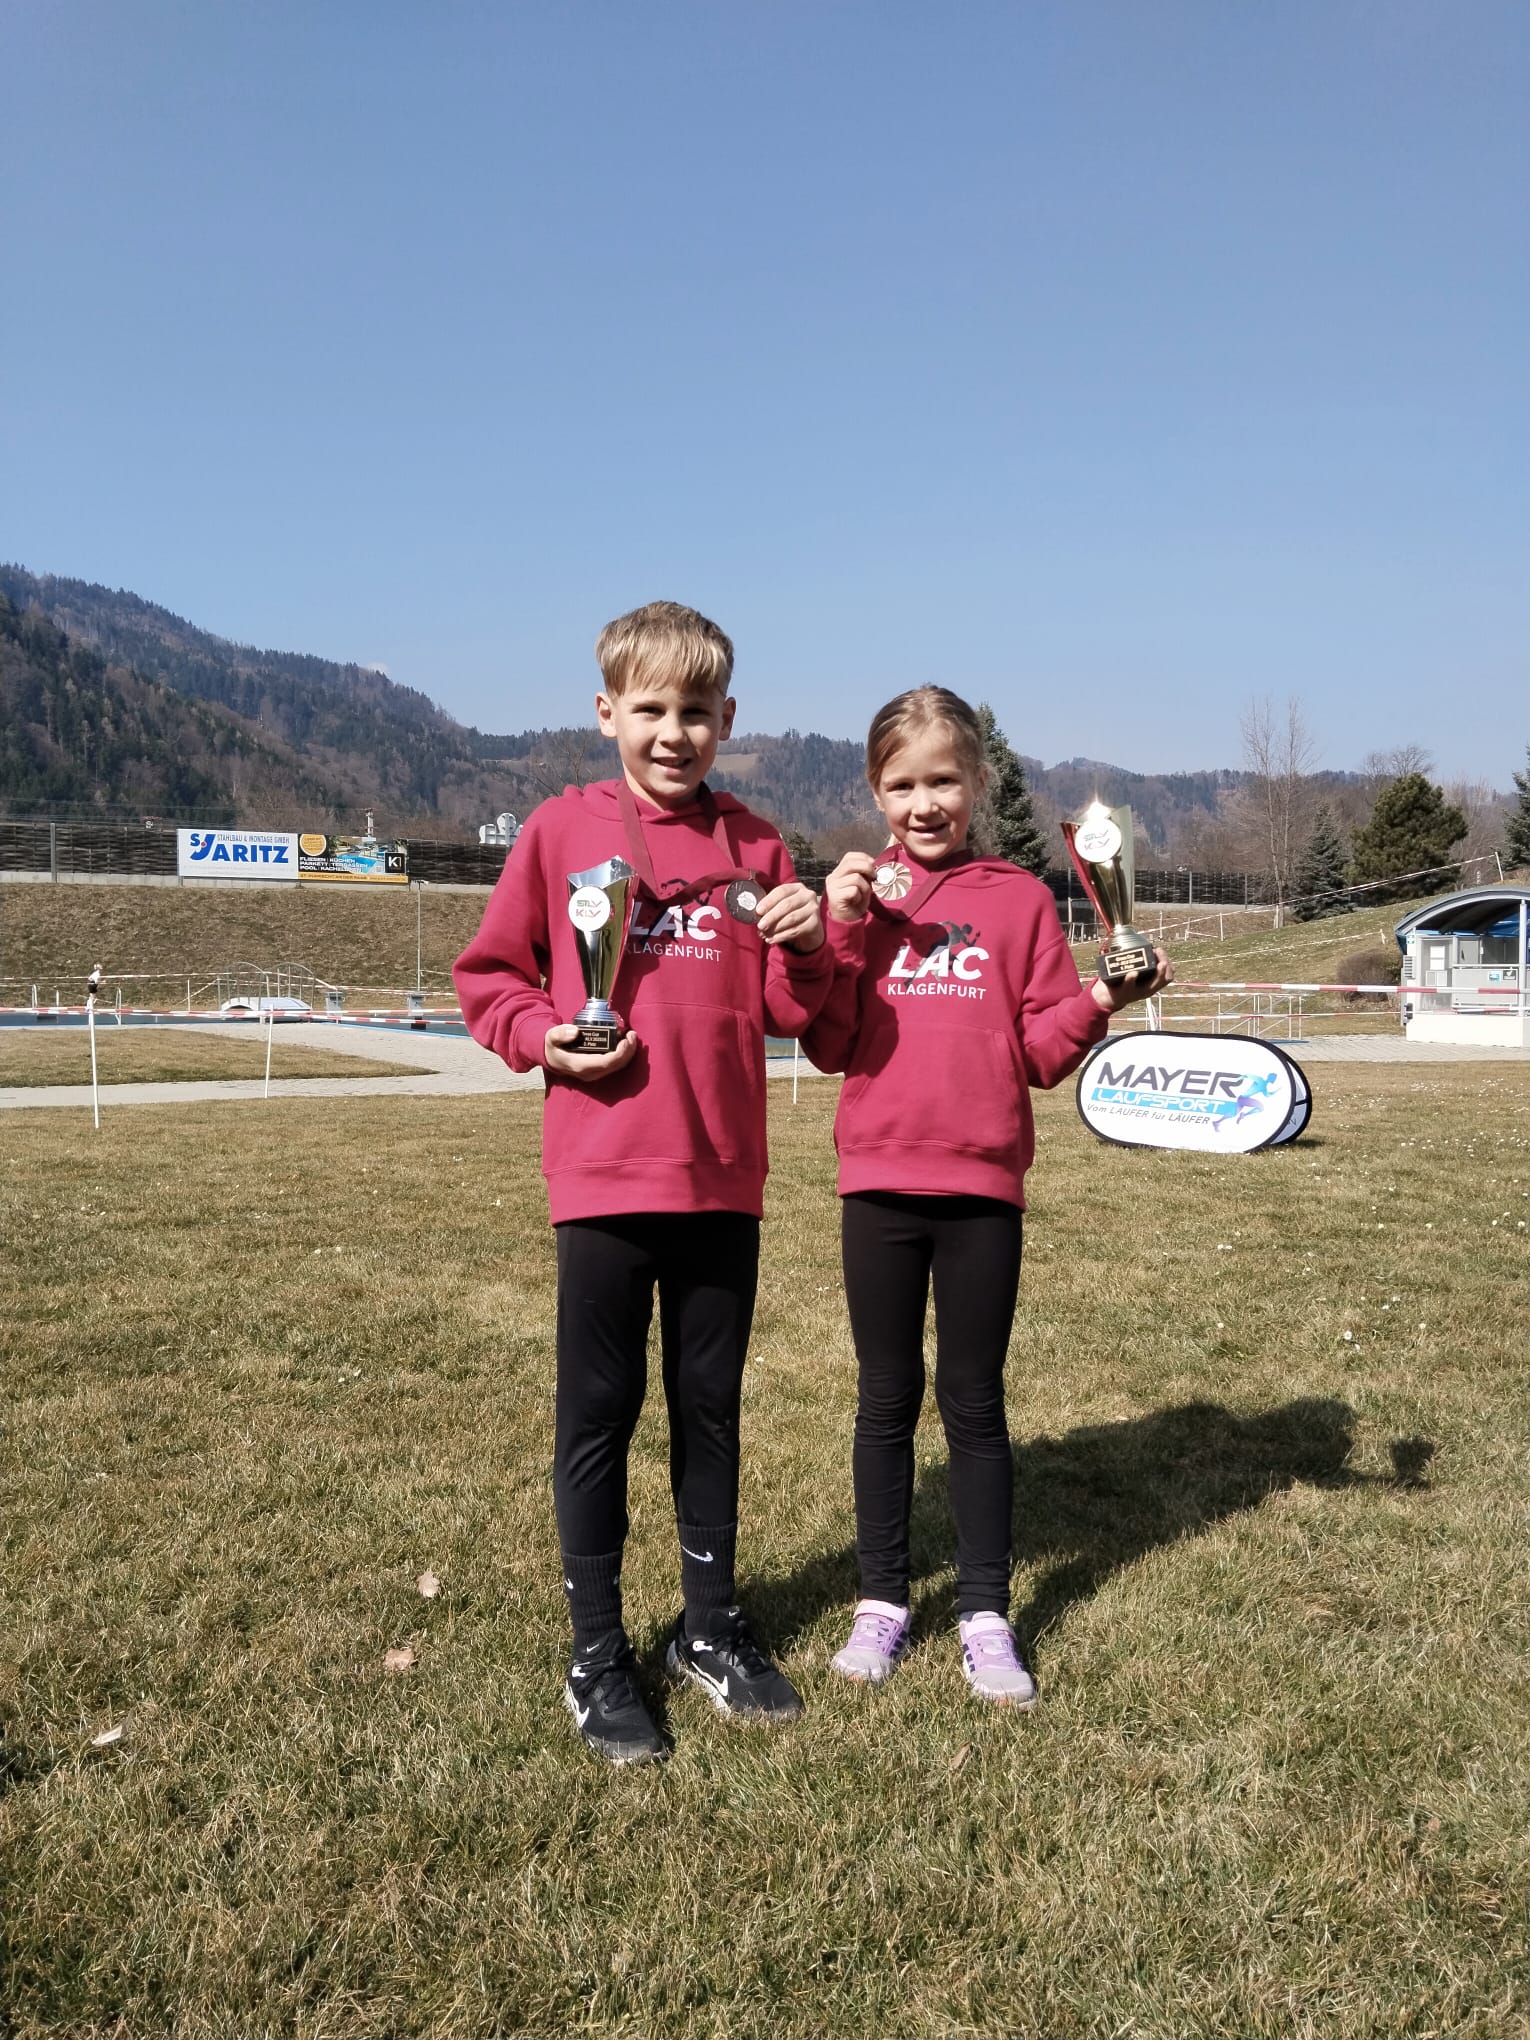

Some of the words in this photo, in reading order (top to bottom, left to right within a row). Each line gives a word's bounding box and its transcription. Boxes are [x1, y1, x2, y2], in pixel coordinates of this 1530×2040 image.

[629, 901, 722, 941] LAC
[888, 945, 990, 980] LAC
[887, 983, 987, 1000] KLAGENFURT
[1097, 1061, 1245, 1099] MAYER
[1087, 1103, 1107, 1113] Vom
[1151, 1110, 1166, 1120] für
[1168, 1112, 1211, 1125] LÄUFER
[1097, 1089, 1227, 1114] LAUFSPORT
